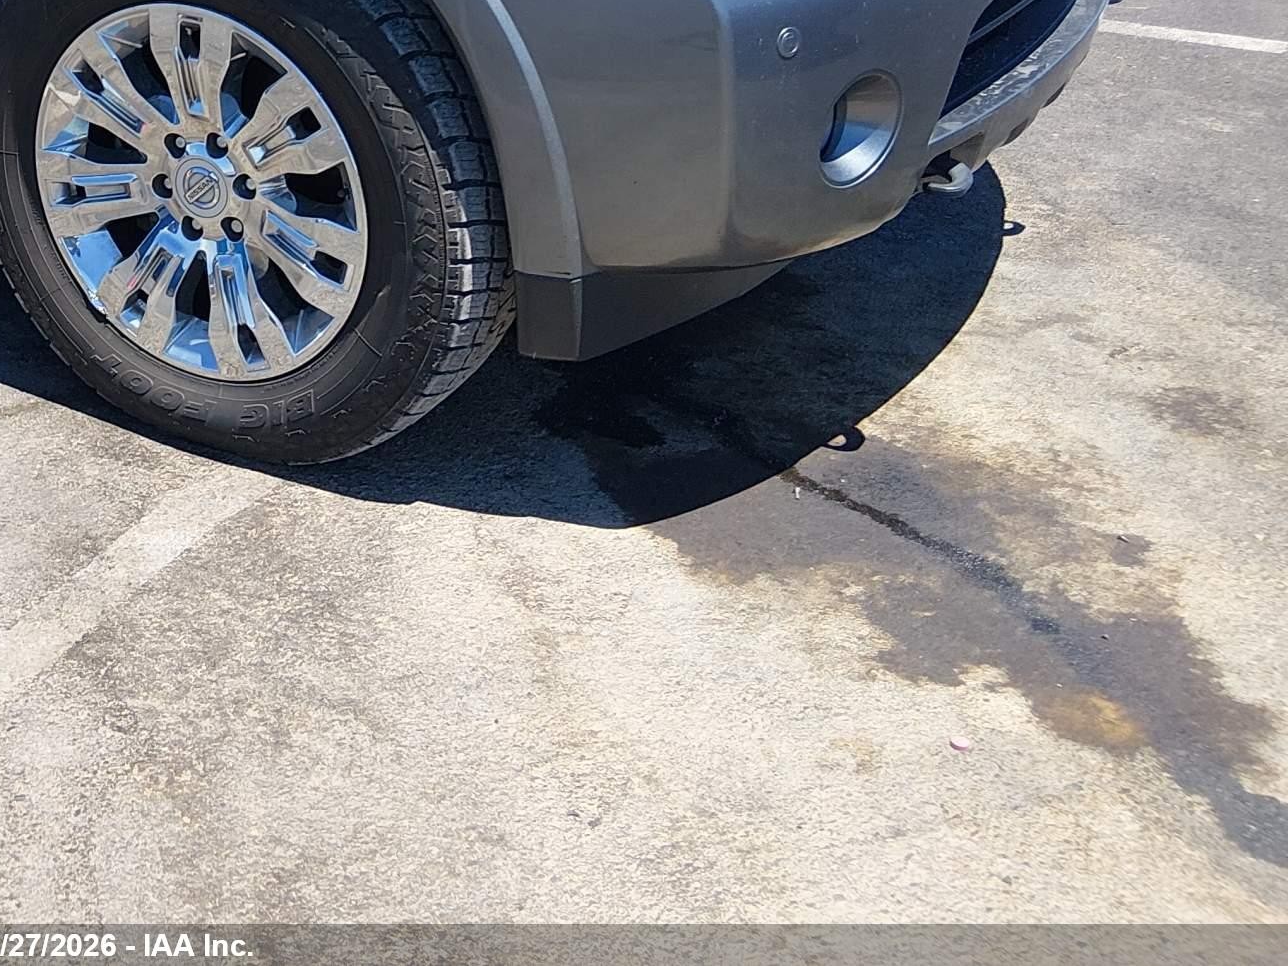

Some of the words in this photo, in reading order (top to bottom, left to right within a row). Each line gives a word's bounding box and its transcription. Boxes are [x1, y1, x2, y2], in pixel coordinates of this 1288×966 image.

[187, 176, 214, 201] NISSAN
[91, 353, 217, 426] FOOT
[239, 388, 315, 429] BIG
